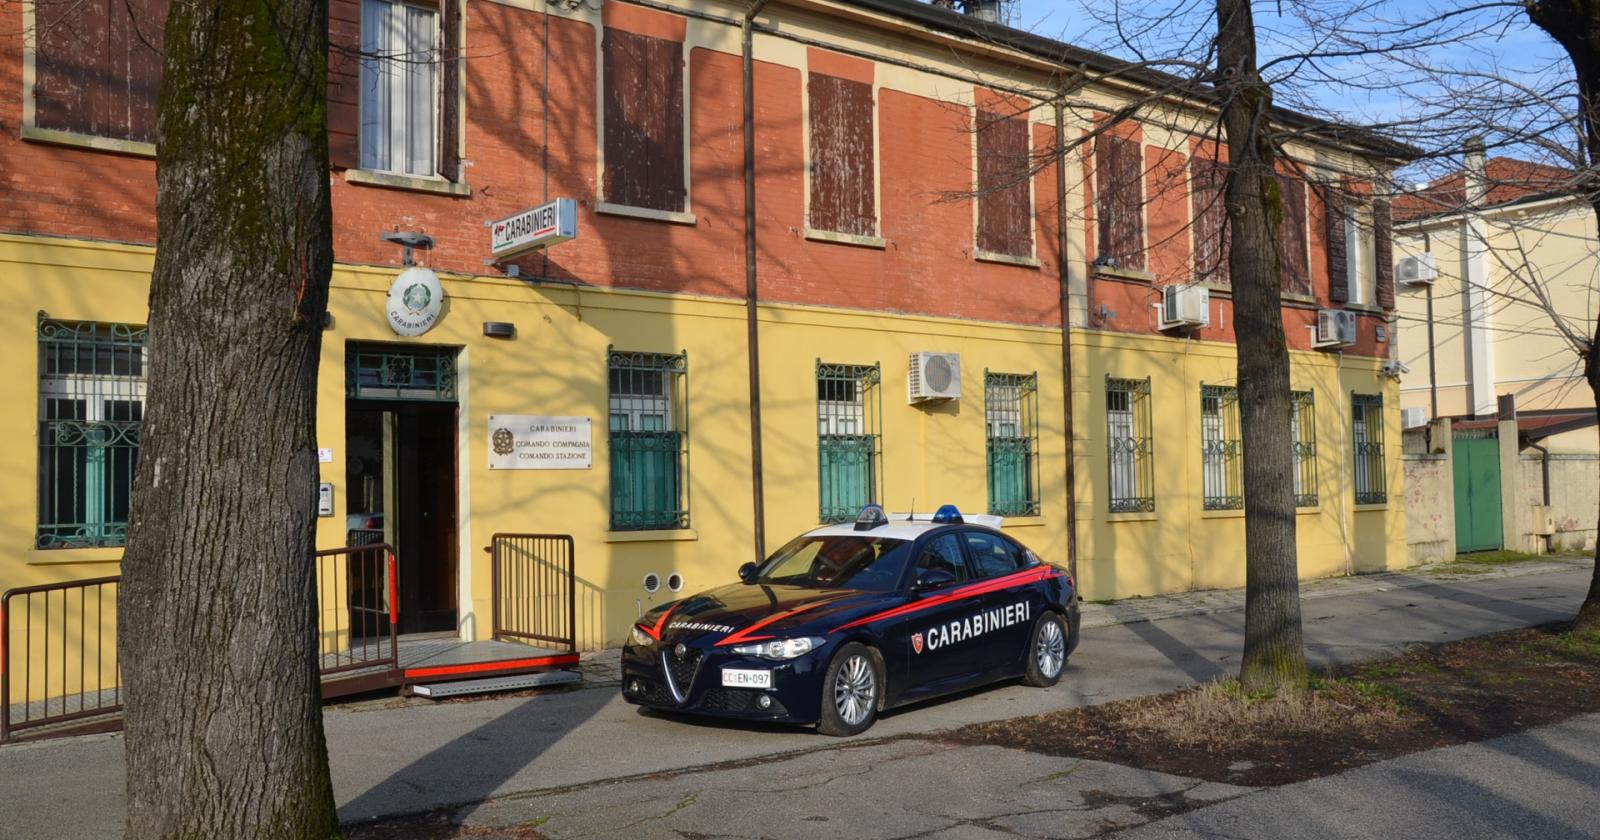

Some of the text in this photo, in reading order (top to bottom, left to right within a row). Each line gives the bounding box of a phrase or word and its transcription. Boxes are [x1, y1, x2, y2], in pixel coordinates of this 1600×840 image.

[505, 204, 556, 241] CARABINIERI
[390, 310, 434, 328] CARABINIERI
[529, 425, 577, 433] CARABINIERI
[515, 440, 590, 448] COMANDO COMPAGNIA
[519, 452, 586, 460] COMANDO STAZIONE
[668, 621, 735, 634] CARABINIERI
[927, 600, 1030, 650] CARABINIERI
